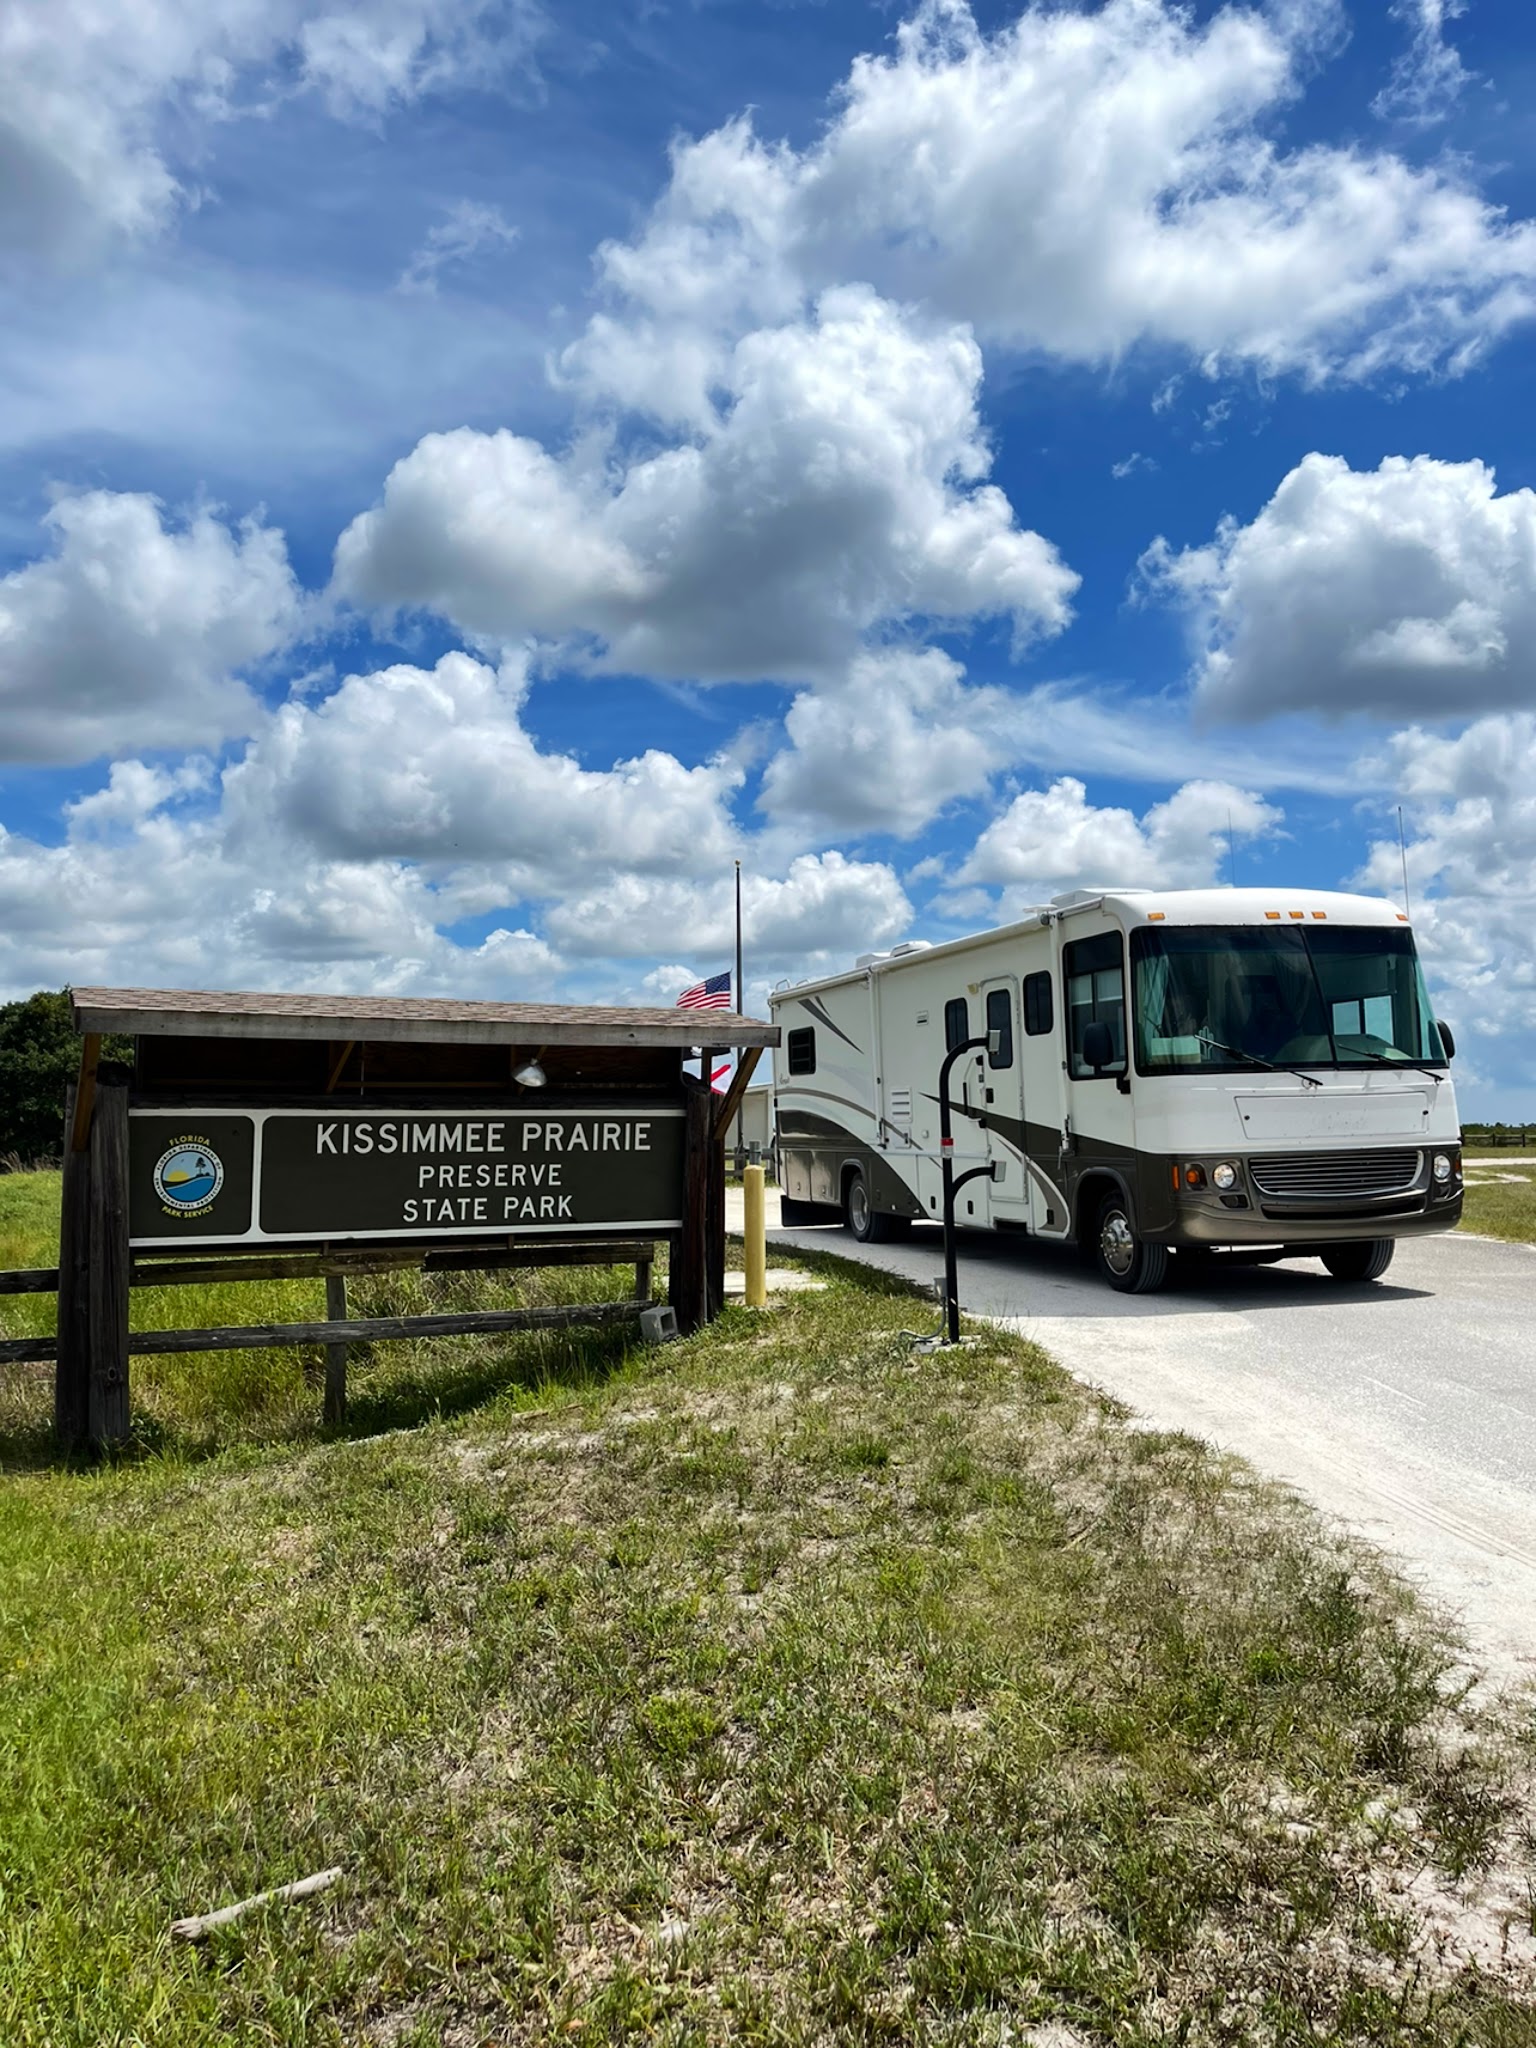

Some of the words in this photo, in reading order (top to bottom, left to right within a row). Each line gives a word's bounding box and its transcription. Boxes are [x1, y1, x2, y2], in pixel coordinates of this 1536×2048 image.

[169, 1135, 210, 1146] FLORIDA
[316, 1123, 505, 1154] KISSIMMEE
[522, 1122, 651, 1152] PRAIRIE
[157, 1148, 177, 1171] FLORIDA
[178, 1144, 217, 1160] DEPARTMENT
[419, 1164, 562, 1189] PRESERVE
[161, 1205, 182, 1218] PARK
[183, 1204, 214, 1218] SERVICE
[403, 1198, 488, 1222] STATE
[504, 1195, 573, 1220] PARK
